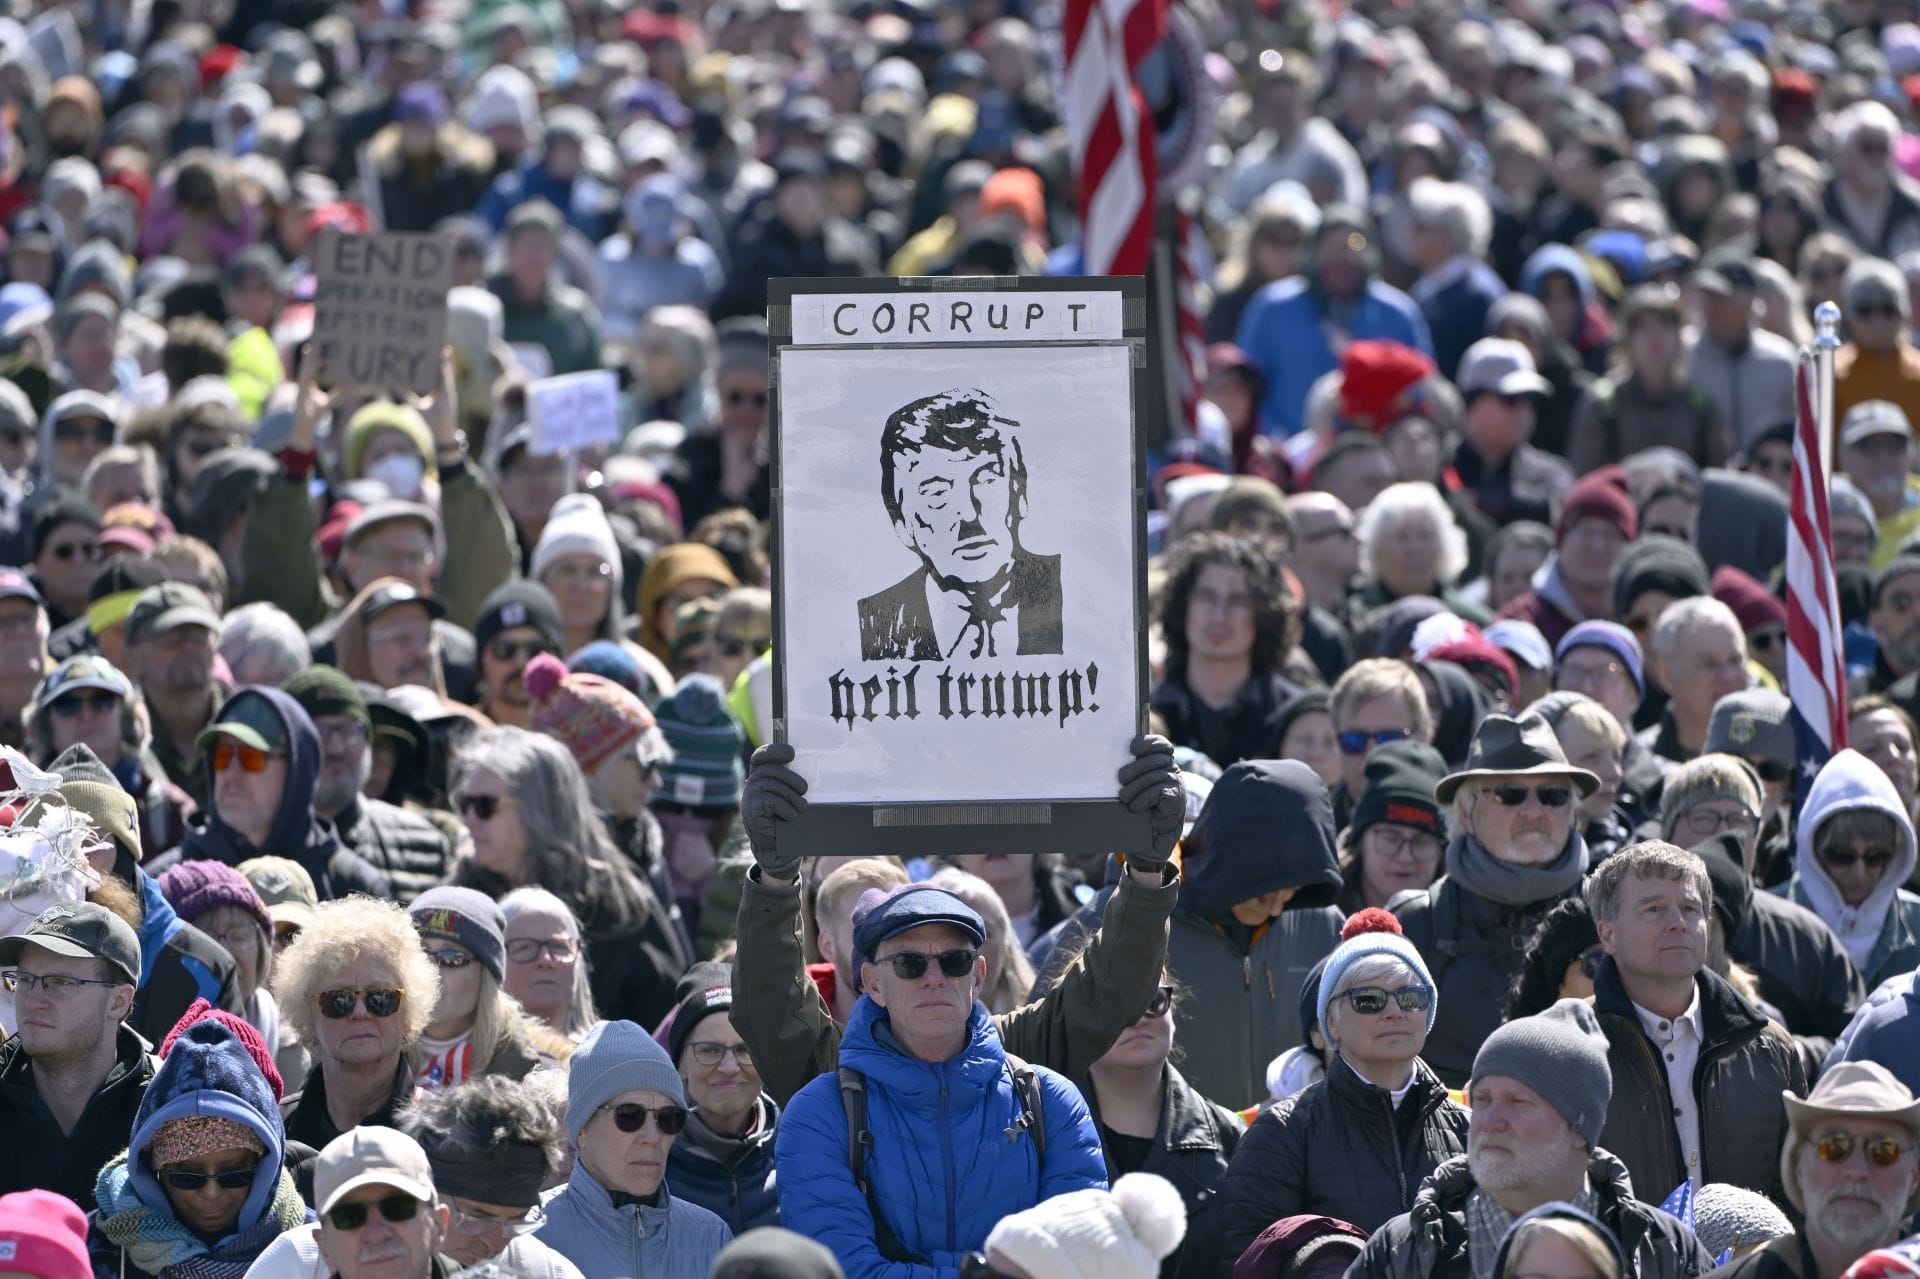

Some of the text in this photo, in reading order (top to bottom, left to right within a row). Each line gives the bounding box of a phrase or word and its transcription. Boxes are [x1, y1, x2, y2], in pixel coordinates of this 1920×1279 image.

[336, 235, 443, 279] END
[833, 301, 1087, 336] CORRUPT
[318, 340, 428, 382] FURY
[828, 660, 1100, 731] heil trump!
